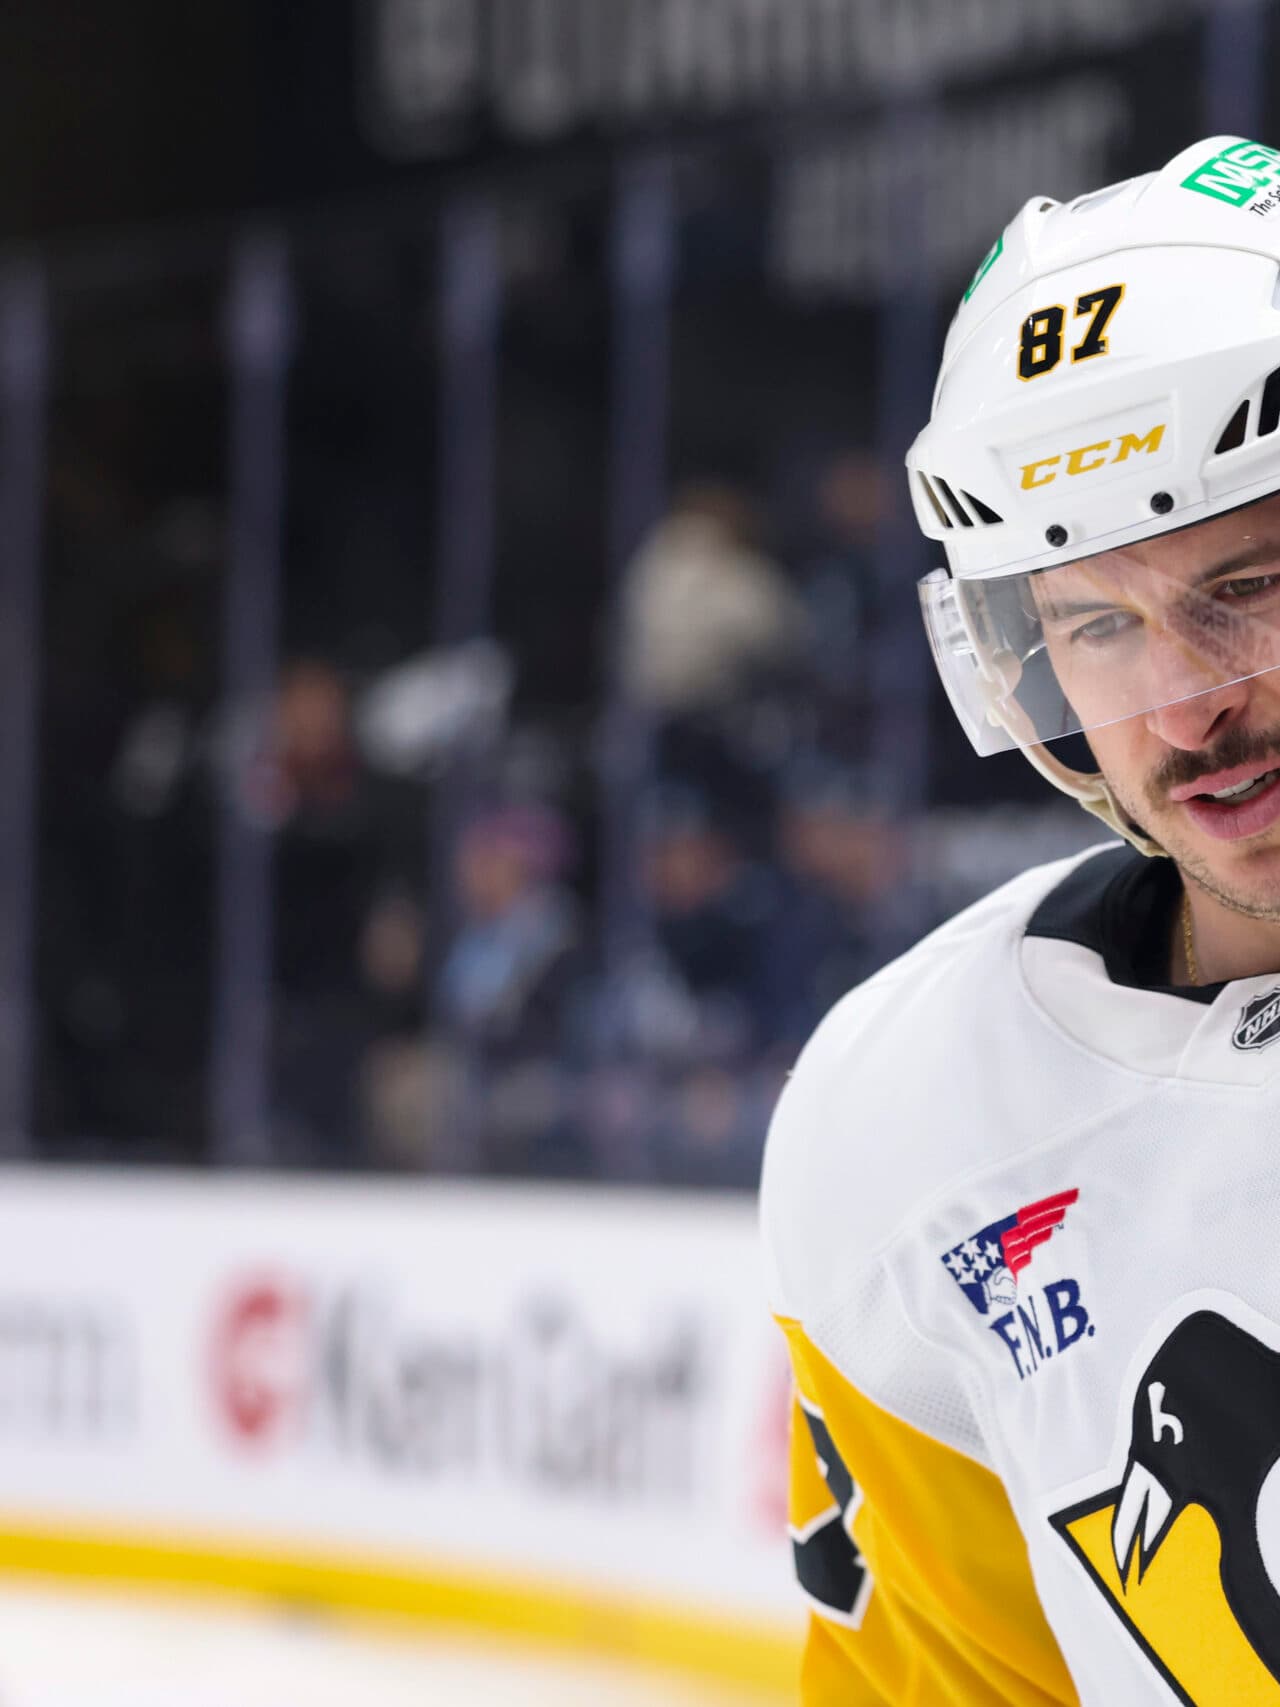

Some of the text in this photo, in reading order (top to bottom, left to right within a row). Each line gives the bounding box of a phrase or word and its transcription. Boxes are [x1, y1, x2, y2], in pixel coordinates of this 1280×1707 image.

[1249, 200, 1276, 216] The
[1017, 283, 1126, 382] 87
[1019, 424, 1167, 490] CCM
[989, 1278, 1096, 1381] F.N.B.
